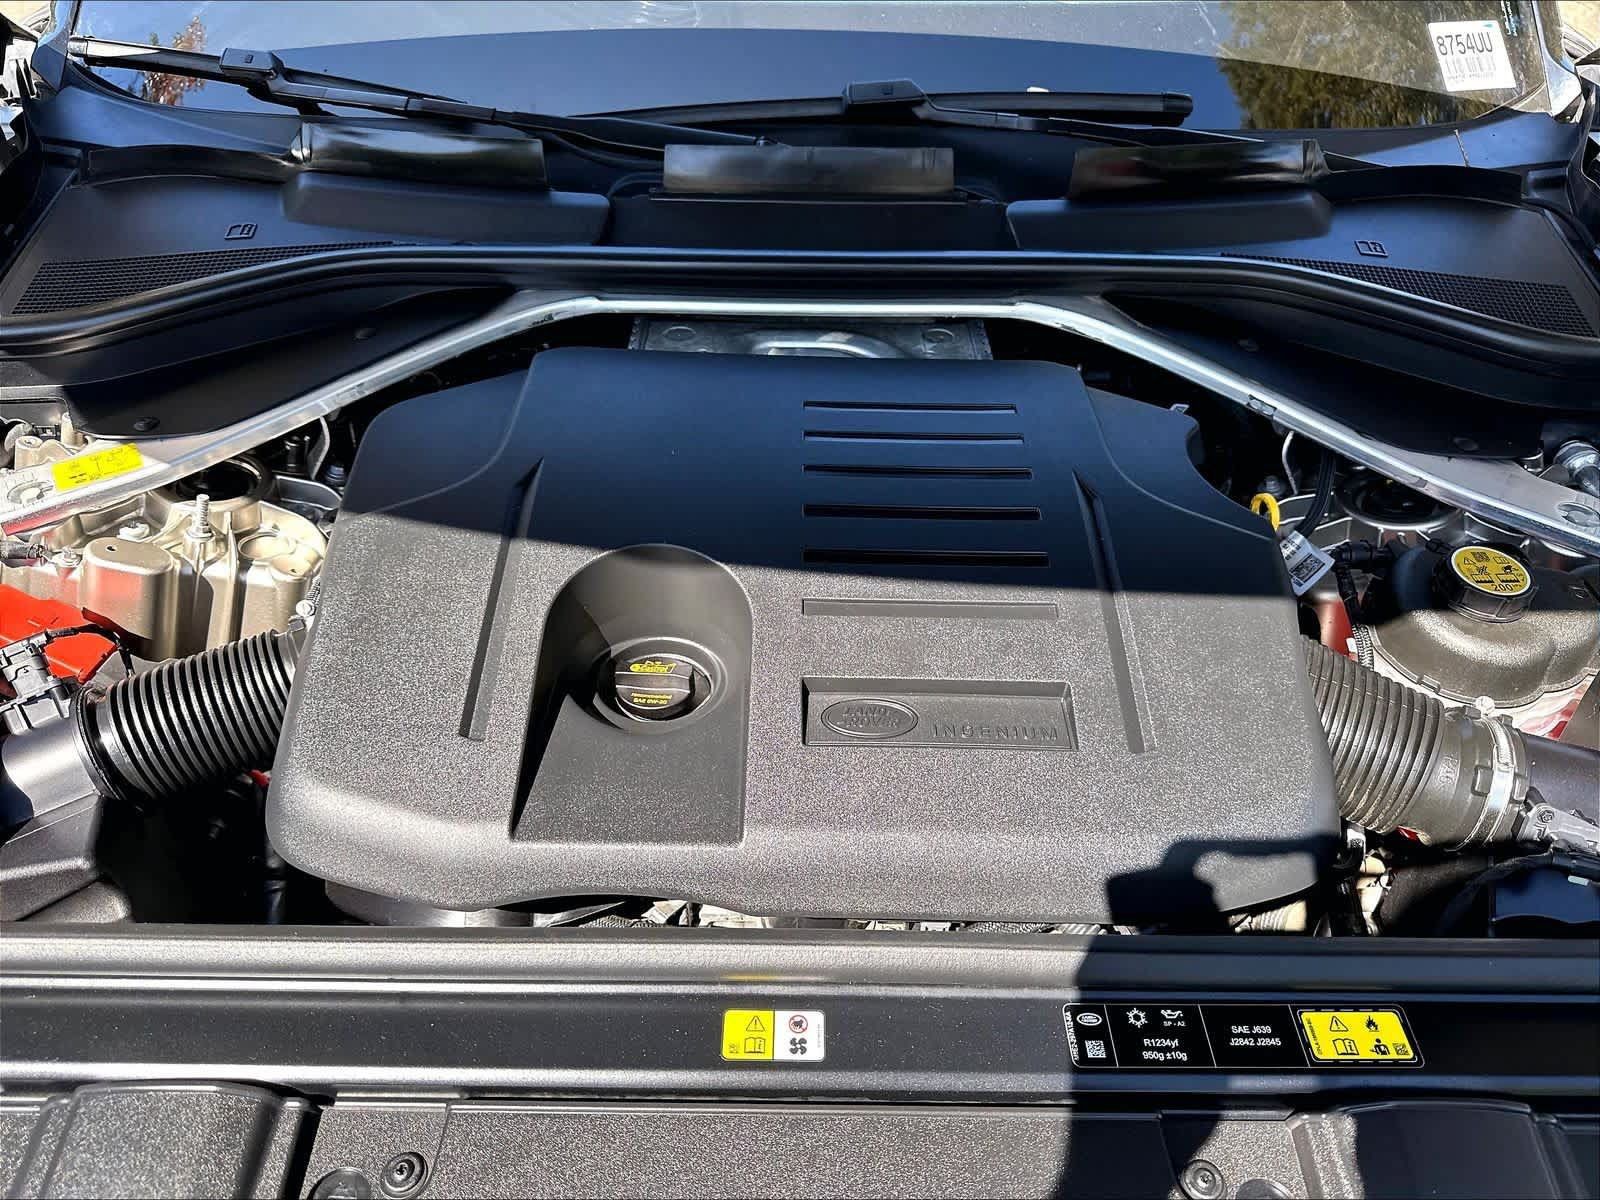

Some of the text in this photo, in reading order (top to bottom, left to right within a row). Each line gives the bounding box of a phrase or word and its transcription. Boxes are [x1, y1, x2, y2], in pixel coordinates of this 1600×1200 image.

[1436, 31, 1493, 56] 8754UU
[932, 722, 1059, 741] INGENIUM
[1231, 1025, 1272, 1034] SAE J639
[1143, 1038, 1179, 1048] R1234yf
[1229, 1037, 1282, 1046] J2842 J2845
[1142, 1051, 1188, 1061] 950g ±10g
